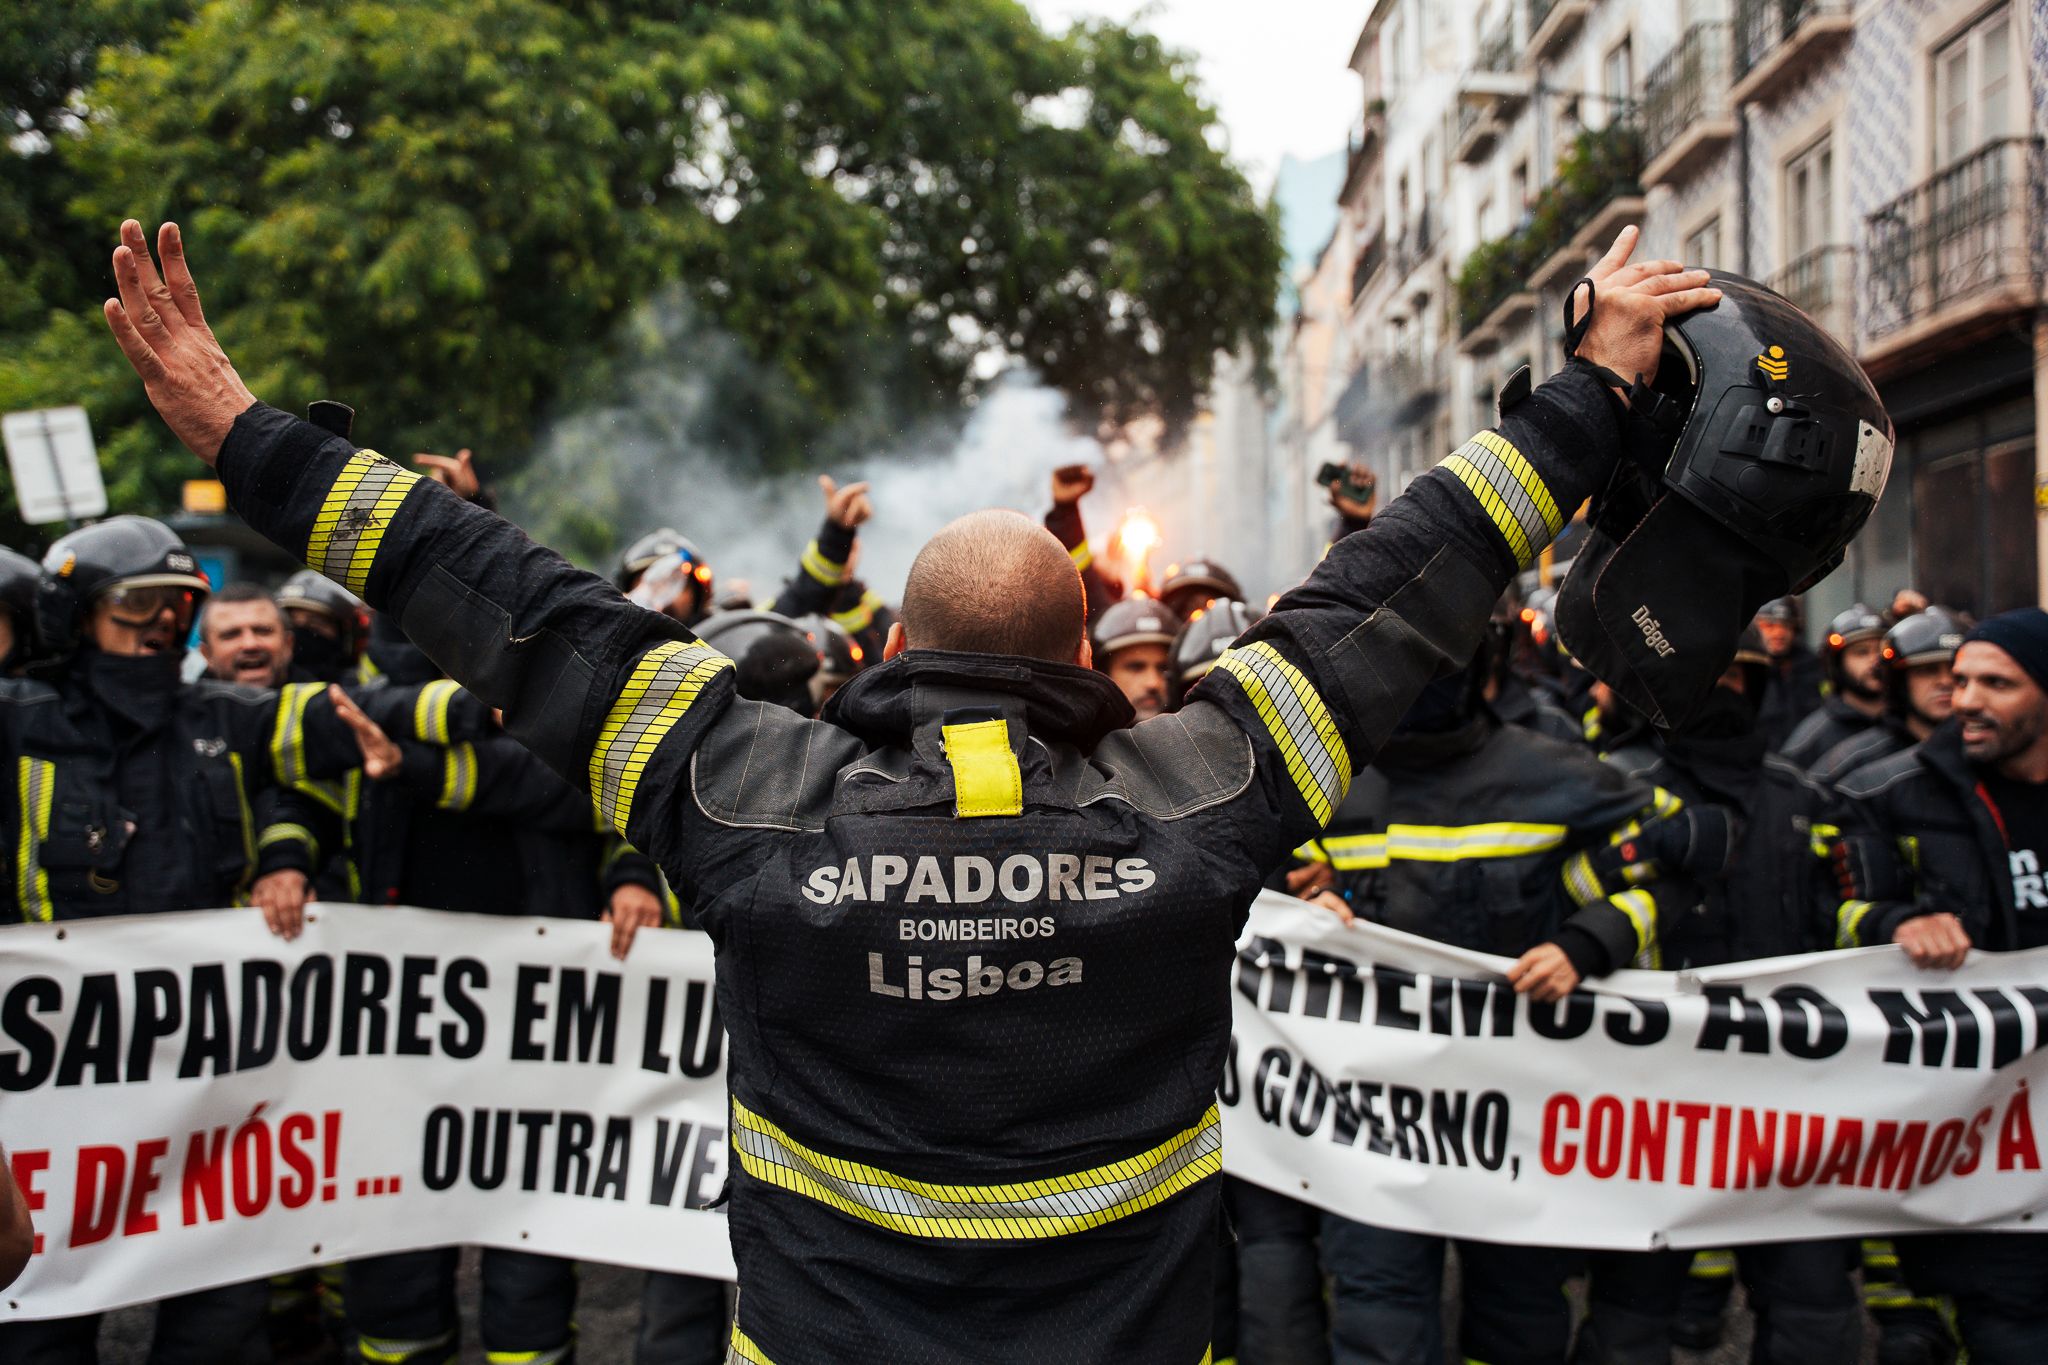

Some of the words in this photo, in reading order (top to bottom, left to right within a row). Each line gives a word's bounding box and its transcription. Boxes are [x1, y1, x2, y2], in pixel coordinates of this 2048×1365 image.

[1632, 605, 1676, 658] Dräger
[801, 853, 1157, 906] SAPADORES
[2013, 873, 2048, 910] R
[900, 916, 1056, 941] BOMBEIROS
[868, 951, 1084, 1001] Lisboa
[0, 953, 489, 1092] SAPADORES
[511, 963, 622, 1065] EM
[1695, 983, 1849, 1060] AO
[1254, 1046, 1519, 1181] GOVERNO,
[1540, 1092, 1994, 1191] CONTINUAMOS
[68, 1136, 170, 1249] DE
[181, 1100, 342, 1228] NÓS!
[421, 1104, 633, 1201] OUTRA
